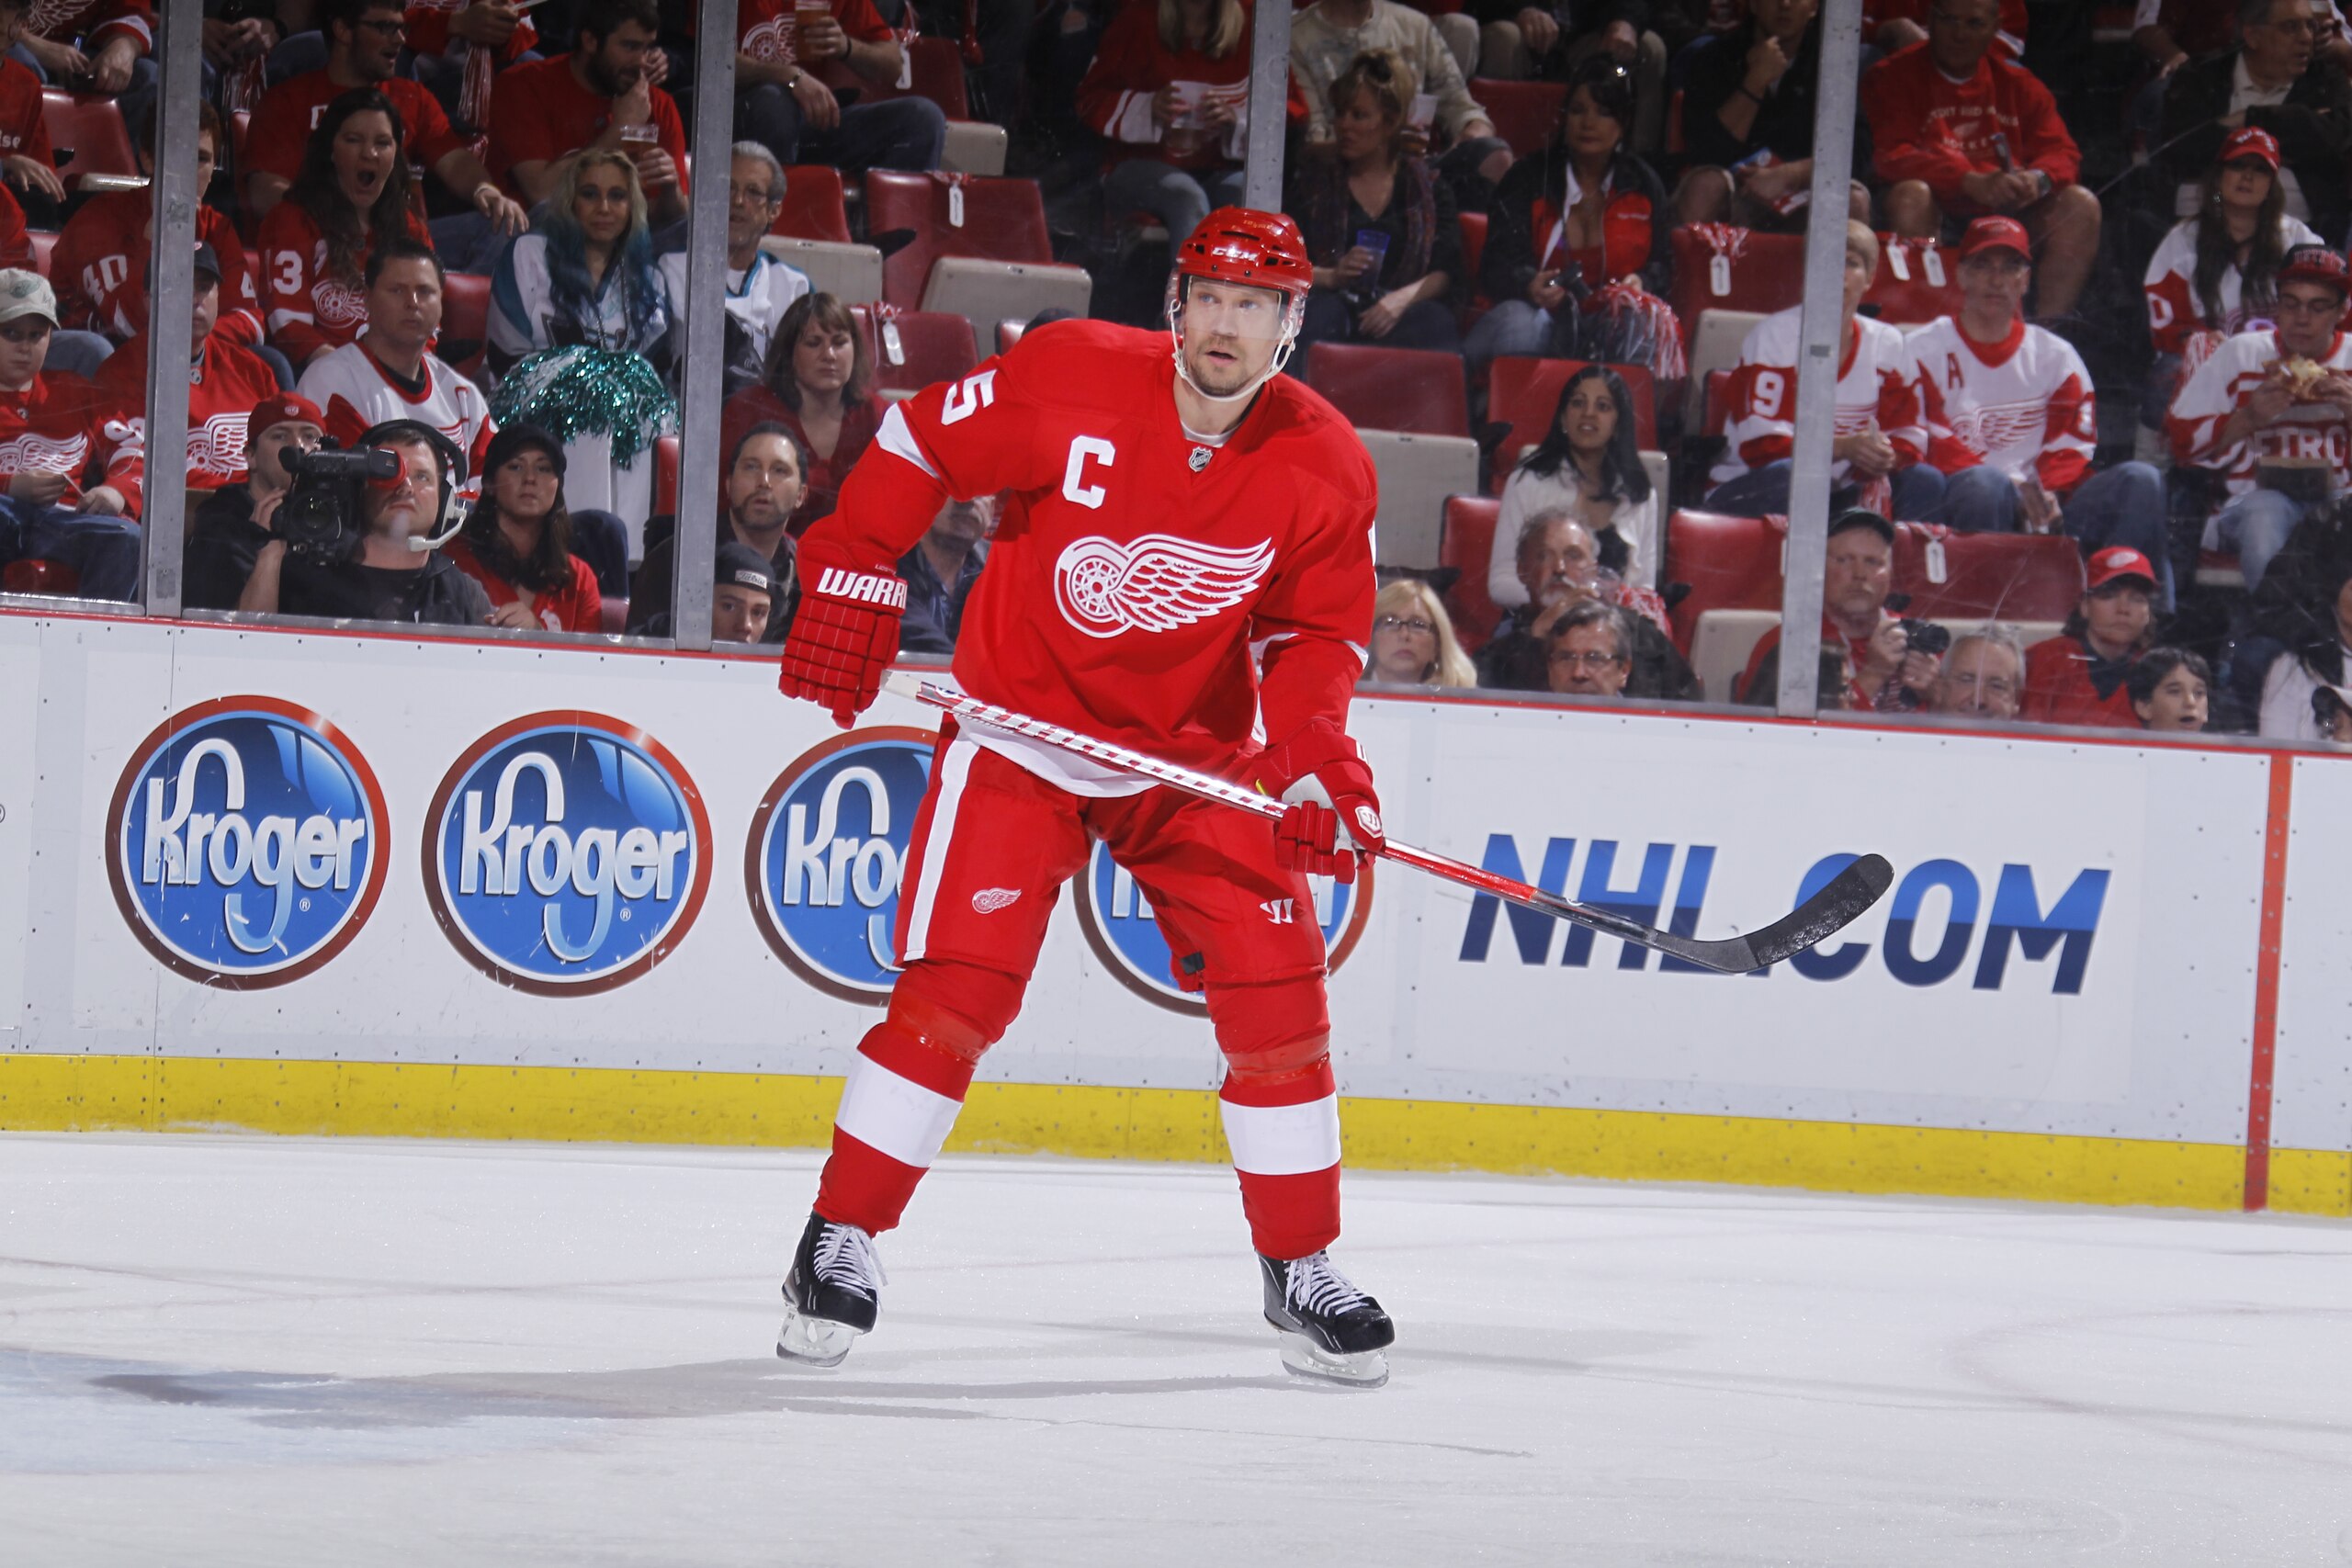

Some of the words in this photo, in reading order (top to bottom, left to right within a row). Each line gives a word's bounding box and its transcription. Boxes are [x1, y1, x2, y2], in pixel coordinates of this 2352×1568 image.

[83, 254, 128, 306] 40
[941, 368, 999, 426] 5
[1947, 352, 1965, 390] A
[1061, 434, 1116, 510] C
[141, 738, 365, 953] Kroger
[459, 751, 687, 963] Kroger
